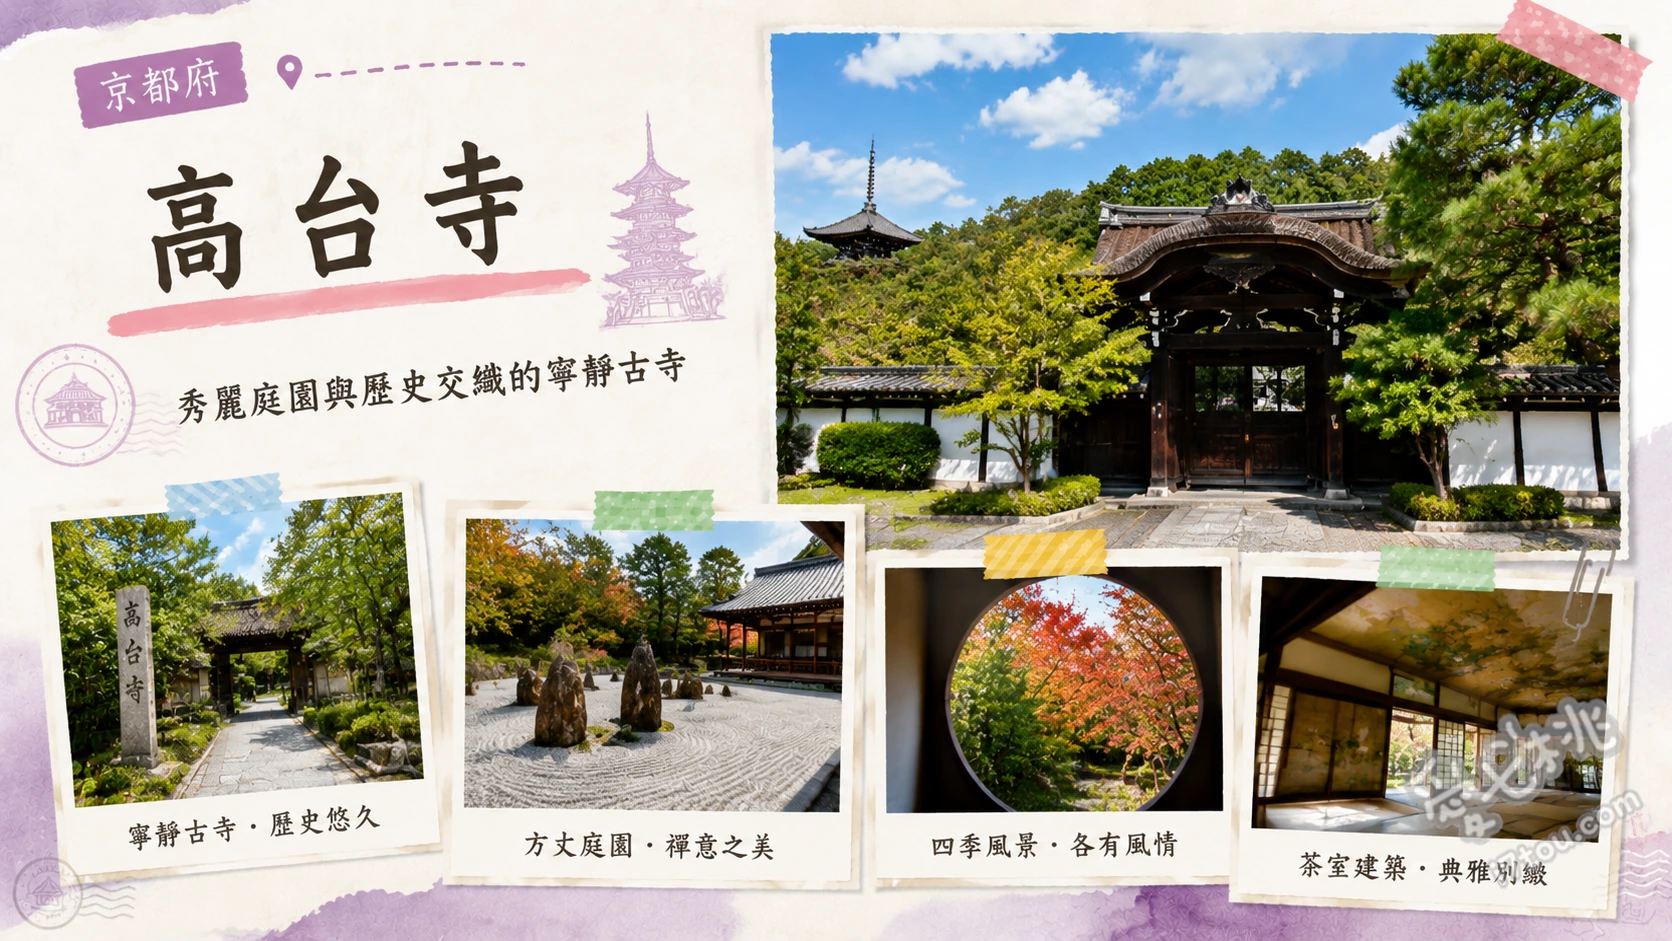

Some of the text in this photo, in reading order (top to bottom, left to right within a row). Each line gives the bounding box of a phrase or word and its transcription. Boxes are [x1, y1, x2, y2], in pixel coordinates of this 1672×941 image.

[100, 57, 220, 112] 京都府
[147, 140, 524, 294] 高台寺
[178, 347, 686, 425] 秀麗庭園與歷史交織的寧靜古寺
[123, 600, 145, 705] 高台寺
